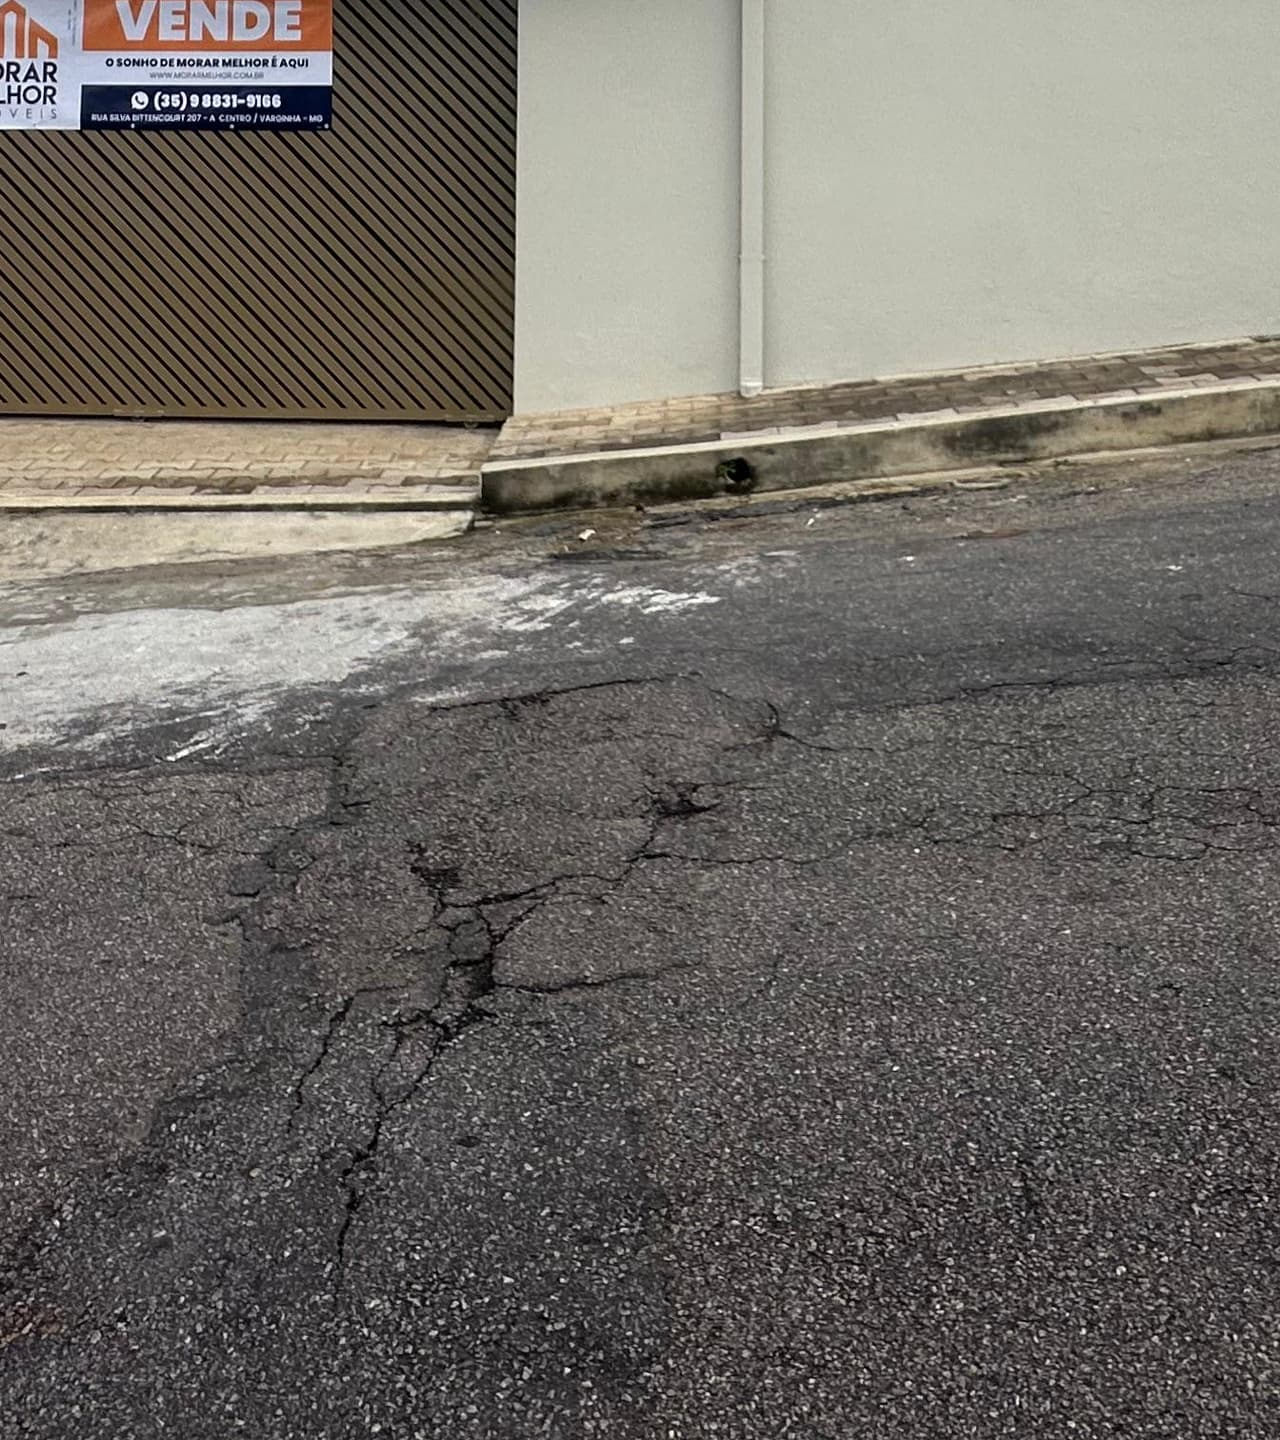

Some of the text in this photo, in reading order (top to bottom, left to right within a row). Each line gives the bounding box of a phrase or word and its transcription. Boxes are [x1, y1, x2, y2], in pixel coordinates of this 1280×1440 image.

[115, 0, 303, 41] VENDE
[105, 55, 309, 69] O SONHO DE MORAR MELHOR É AQUI
[153, 91, 187, 111] (35)
[91, 113, 107, 121] RUA
[218, 114, 251, 122] CENTRO
